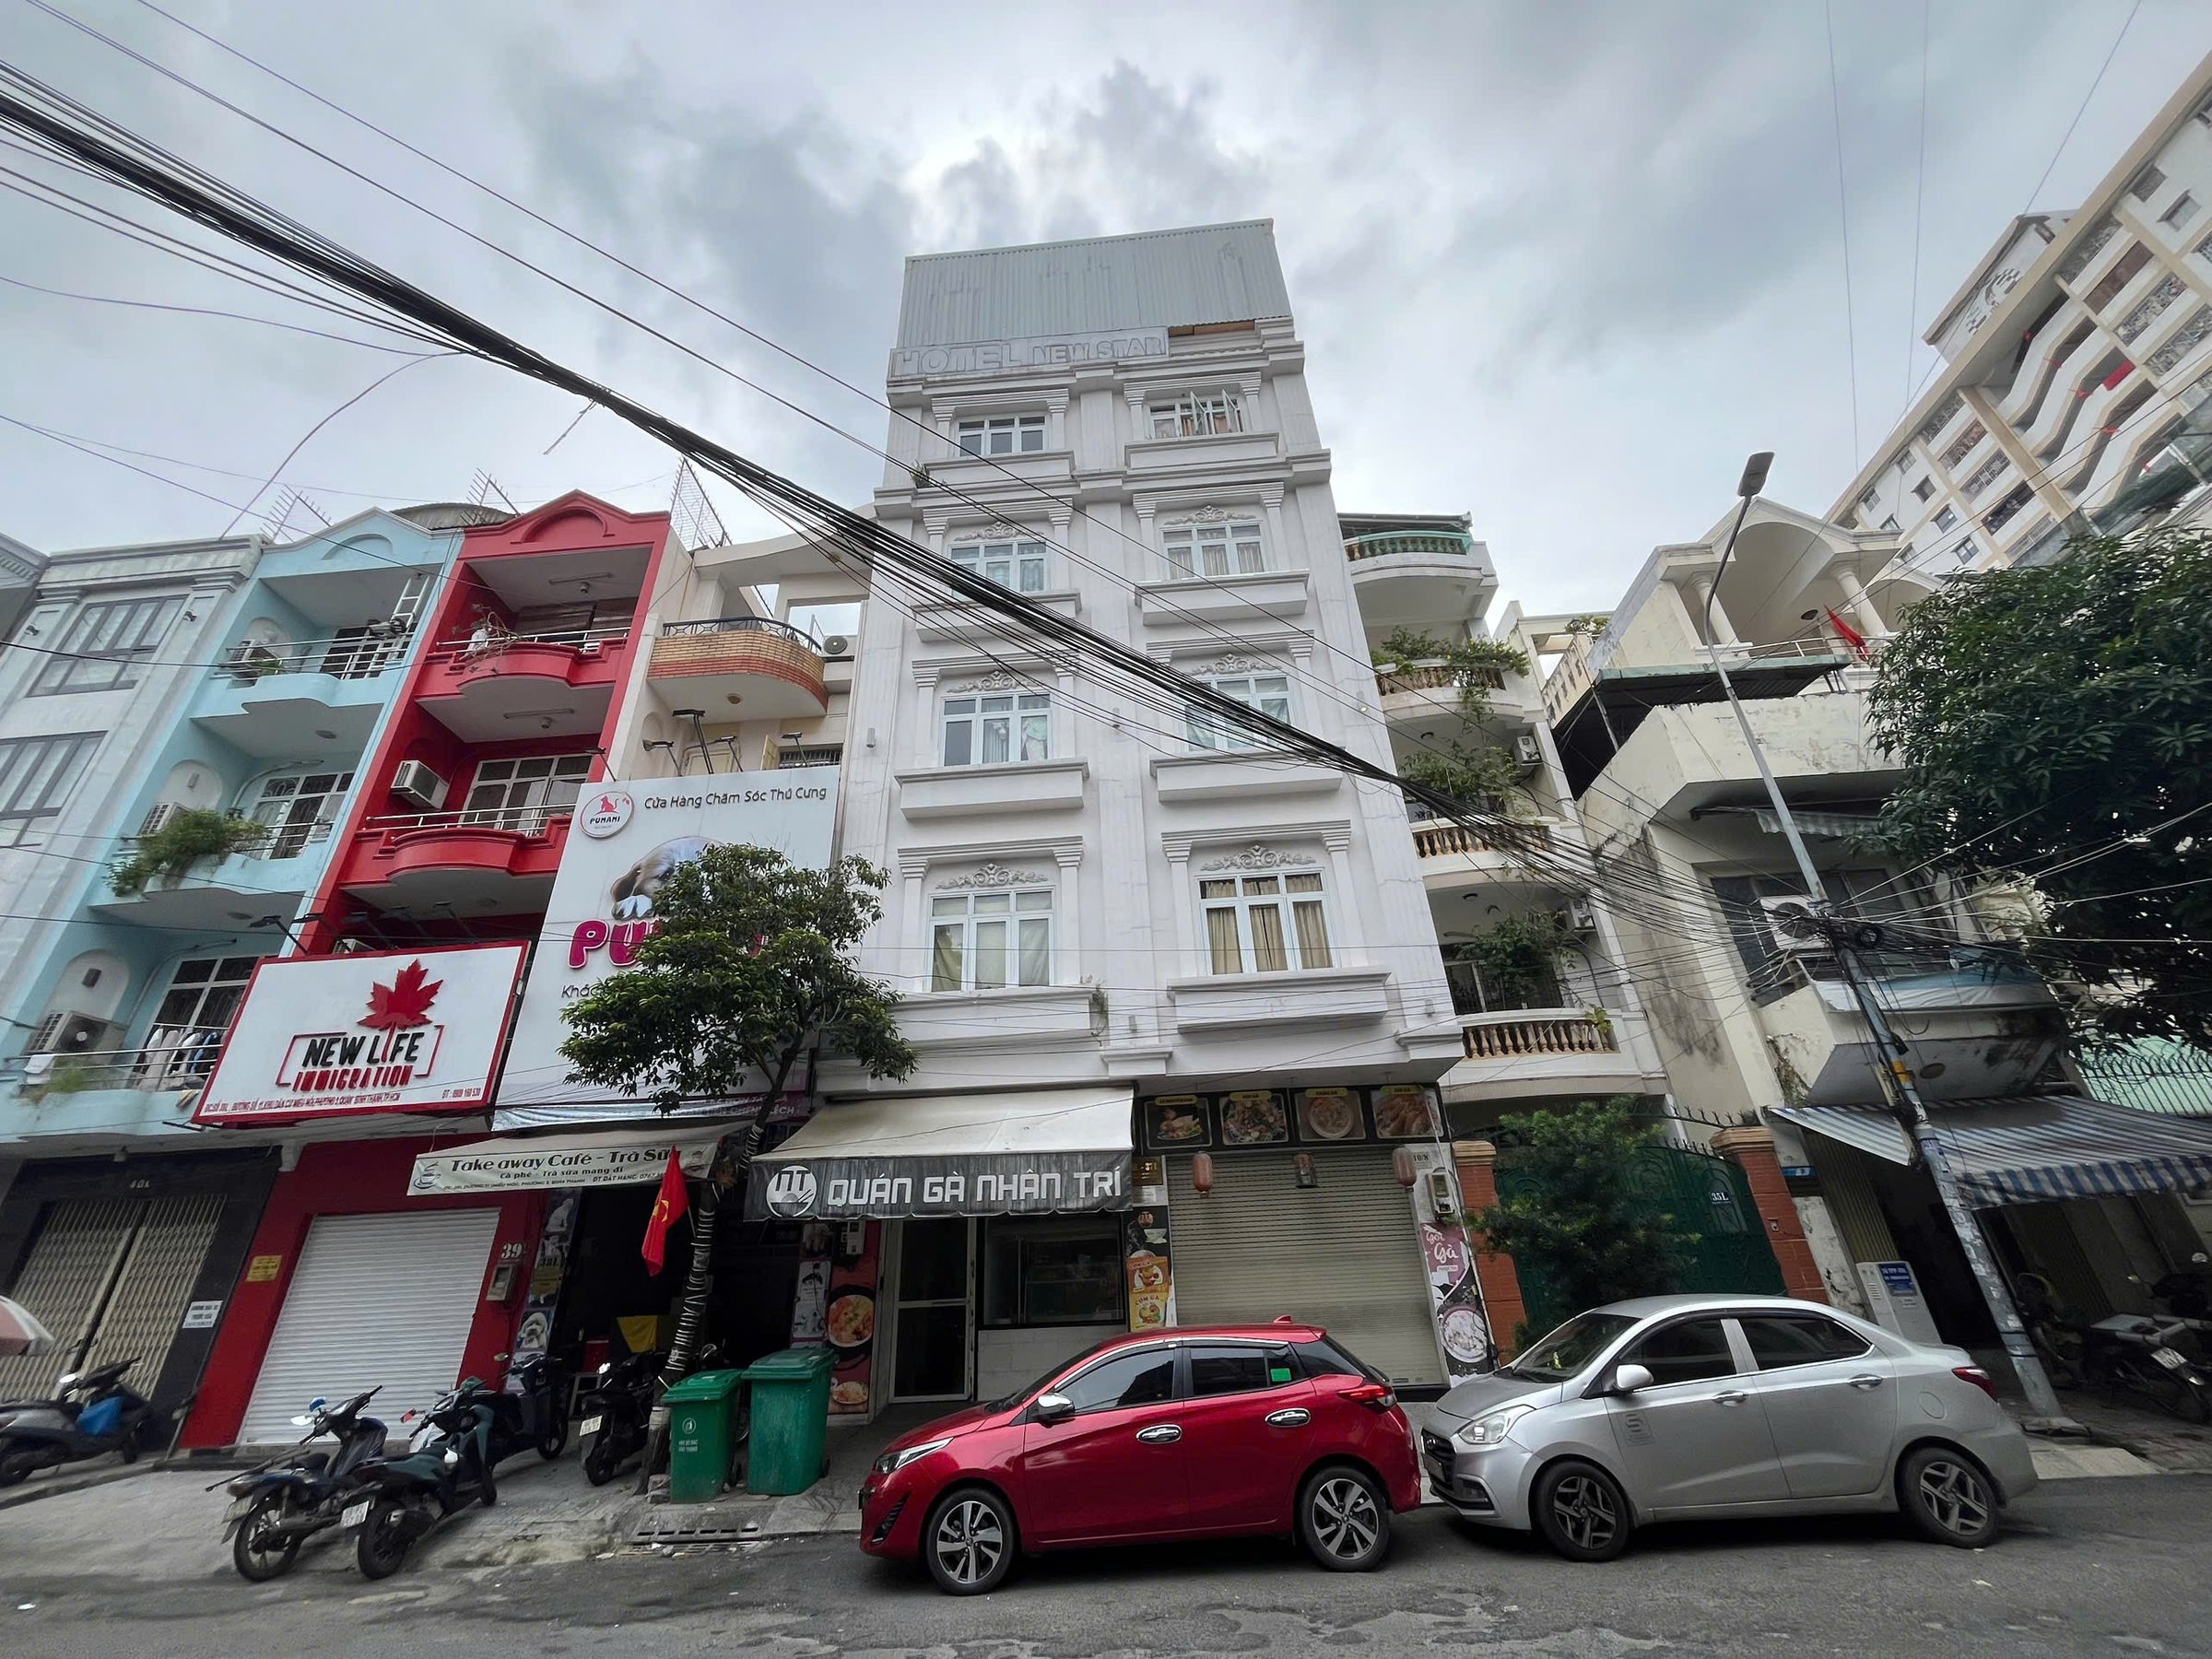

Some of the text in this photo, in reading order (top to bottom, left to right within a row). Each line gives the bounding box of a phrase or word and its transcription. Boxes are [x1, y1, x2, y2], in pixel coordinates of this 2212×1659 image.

[894, 336, 1164, 377] HOTEL NEW STAR
[644, 786, 828, 809] Cửa Hàng Chăm Sóc Thú Cưng
[302, 1034, 367, 1068] NEW
[291, 1065, 415, 1093] IMMIGRATION
[452, 1159, 495, 1171] Take
[498, 1157, 546, 1171] away
[548, 1152, 593, 1167] Café
[609, 1150, 641, 1163] Trà
[500, 1171, 512, 1180] Cà
[582, 1168, 610, 1176] mang
[613, 1165, 624, 1173] đi
[828, 1173, 912, 1206] QUÁN
[923, 1171, 966, 1204] GÀ
[977, 1169, 1062, 1202] NHÂN
[1074, 1165, 1122, 1198] TRÍ
[1711, 1192, 1730, 1202] 35L
